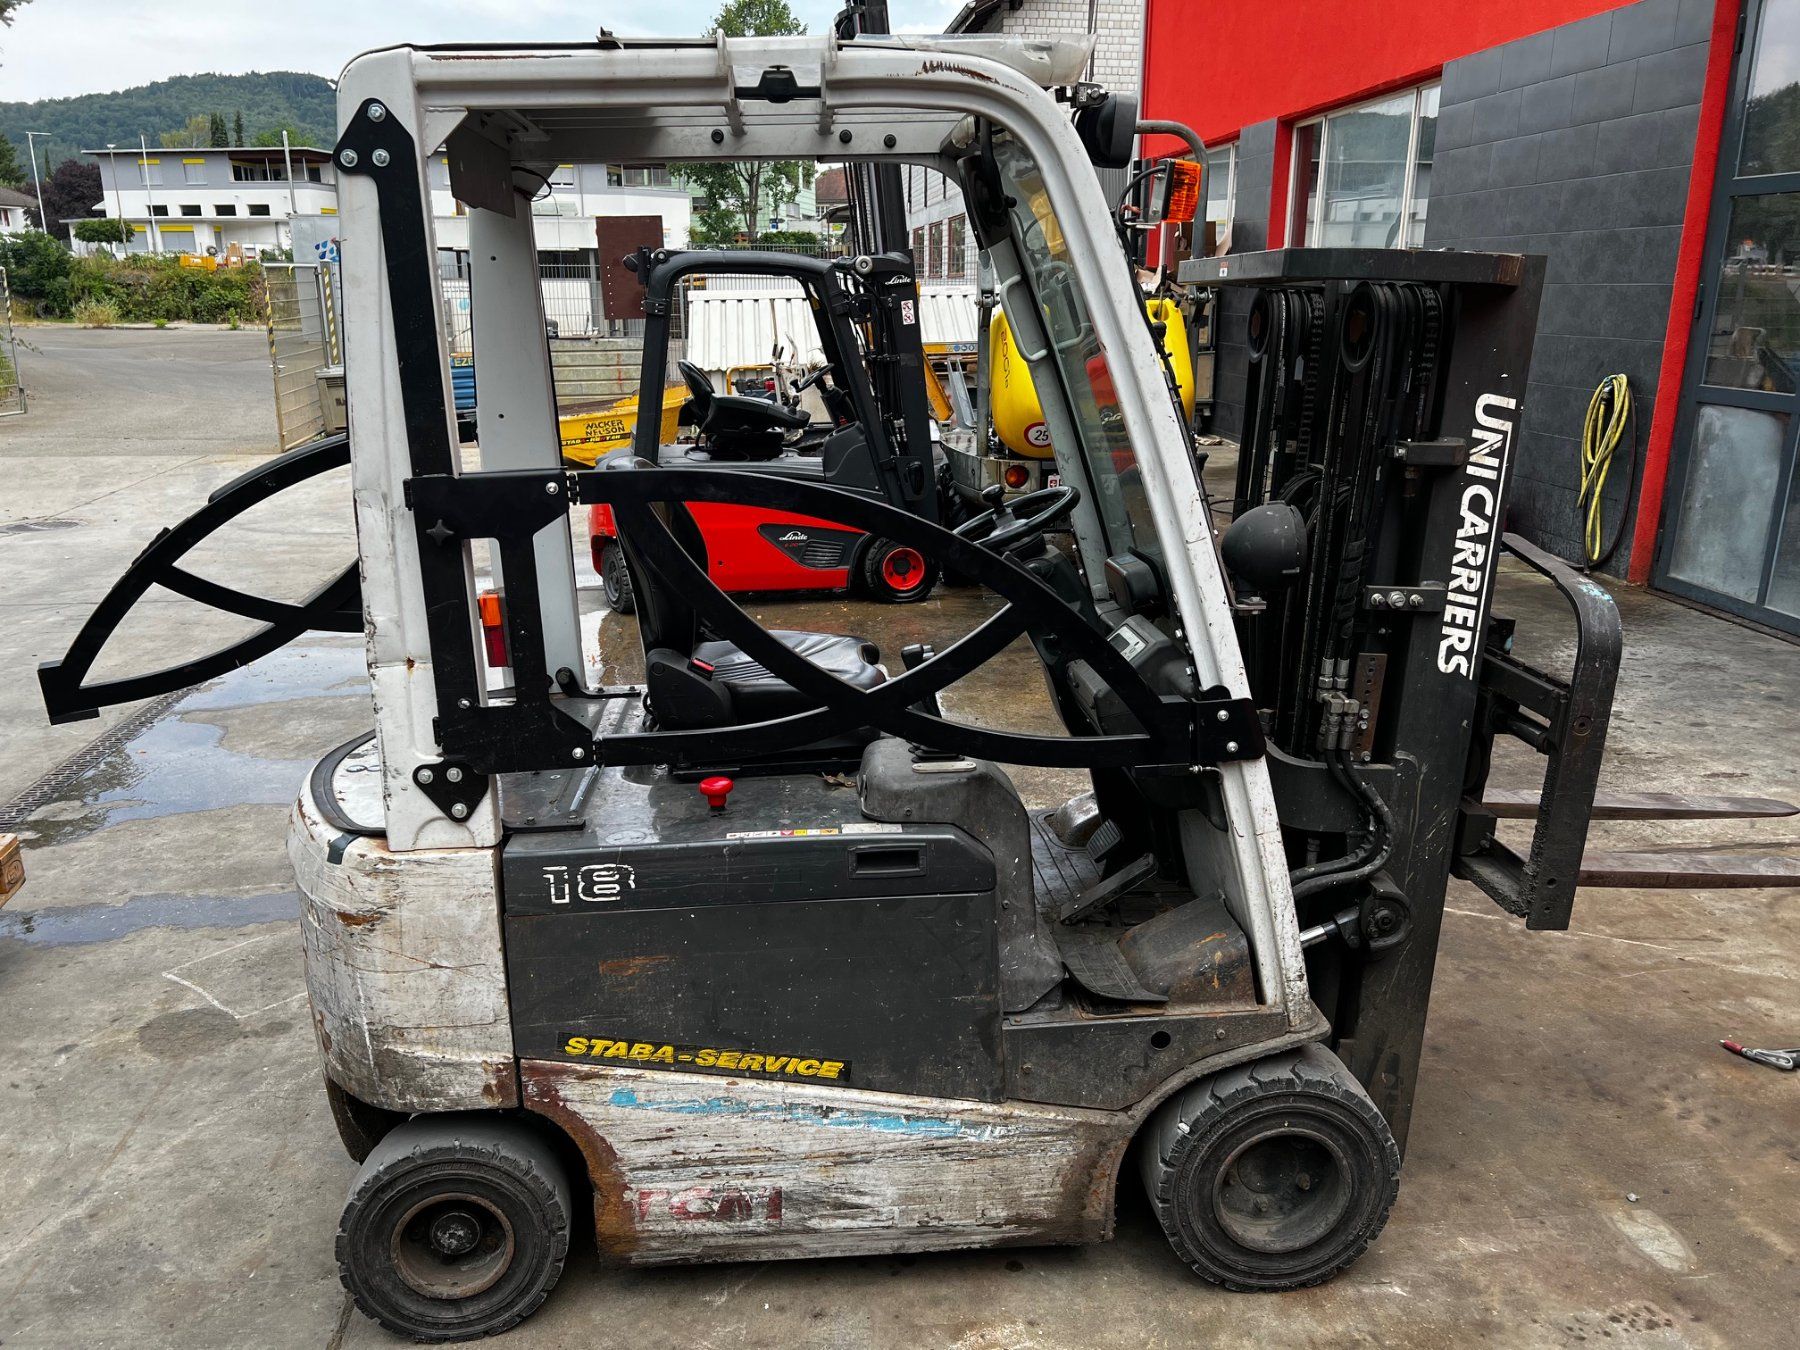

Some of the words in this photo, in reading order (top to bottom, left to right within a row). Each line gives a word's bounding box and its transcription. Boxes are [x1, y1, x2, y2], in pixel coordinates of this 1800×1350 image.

[885, 274, 911, 285] Linde
[1034, 429, 1049, 442] 25
[779, 530, 808, 541] Linde
[1437, 392, 1517, 678] UNICARRIERS
[542, 863, 636, 904] 18
[564, 1036, 845, 1079] STABA-SERVICE
